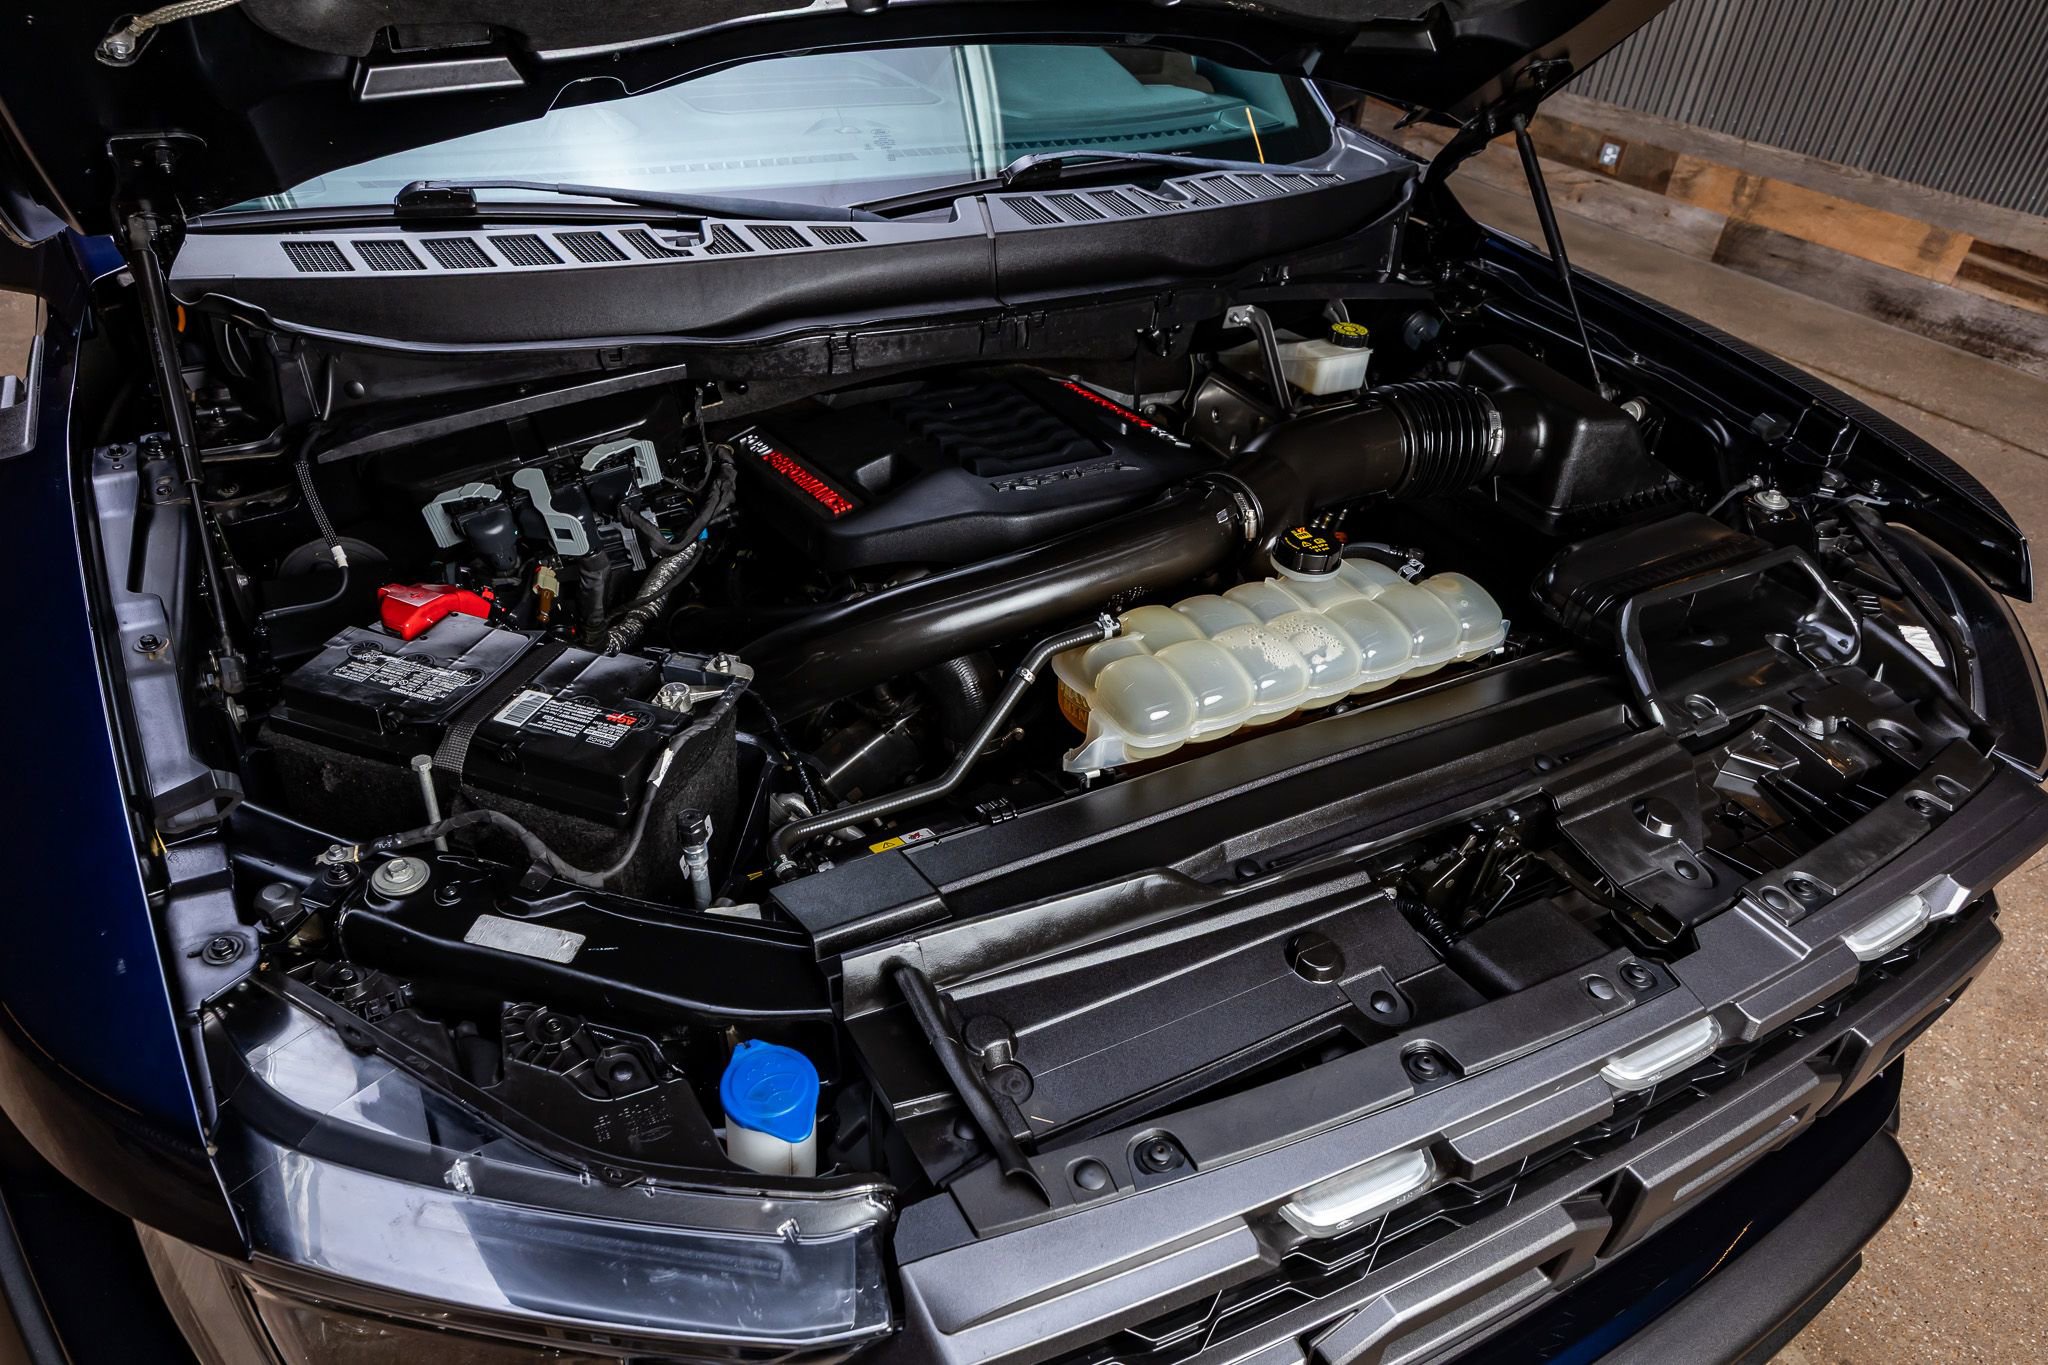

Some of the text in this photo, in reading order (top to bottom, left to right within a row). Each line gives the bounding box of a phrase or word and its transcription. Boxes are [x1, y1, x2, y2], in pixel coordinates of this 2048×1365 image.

[763, 451, 853, 516] PERFORMANCE
[606, 714, 637, 725] AGM
[588, 737, 613, 747] FoMoCo
